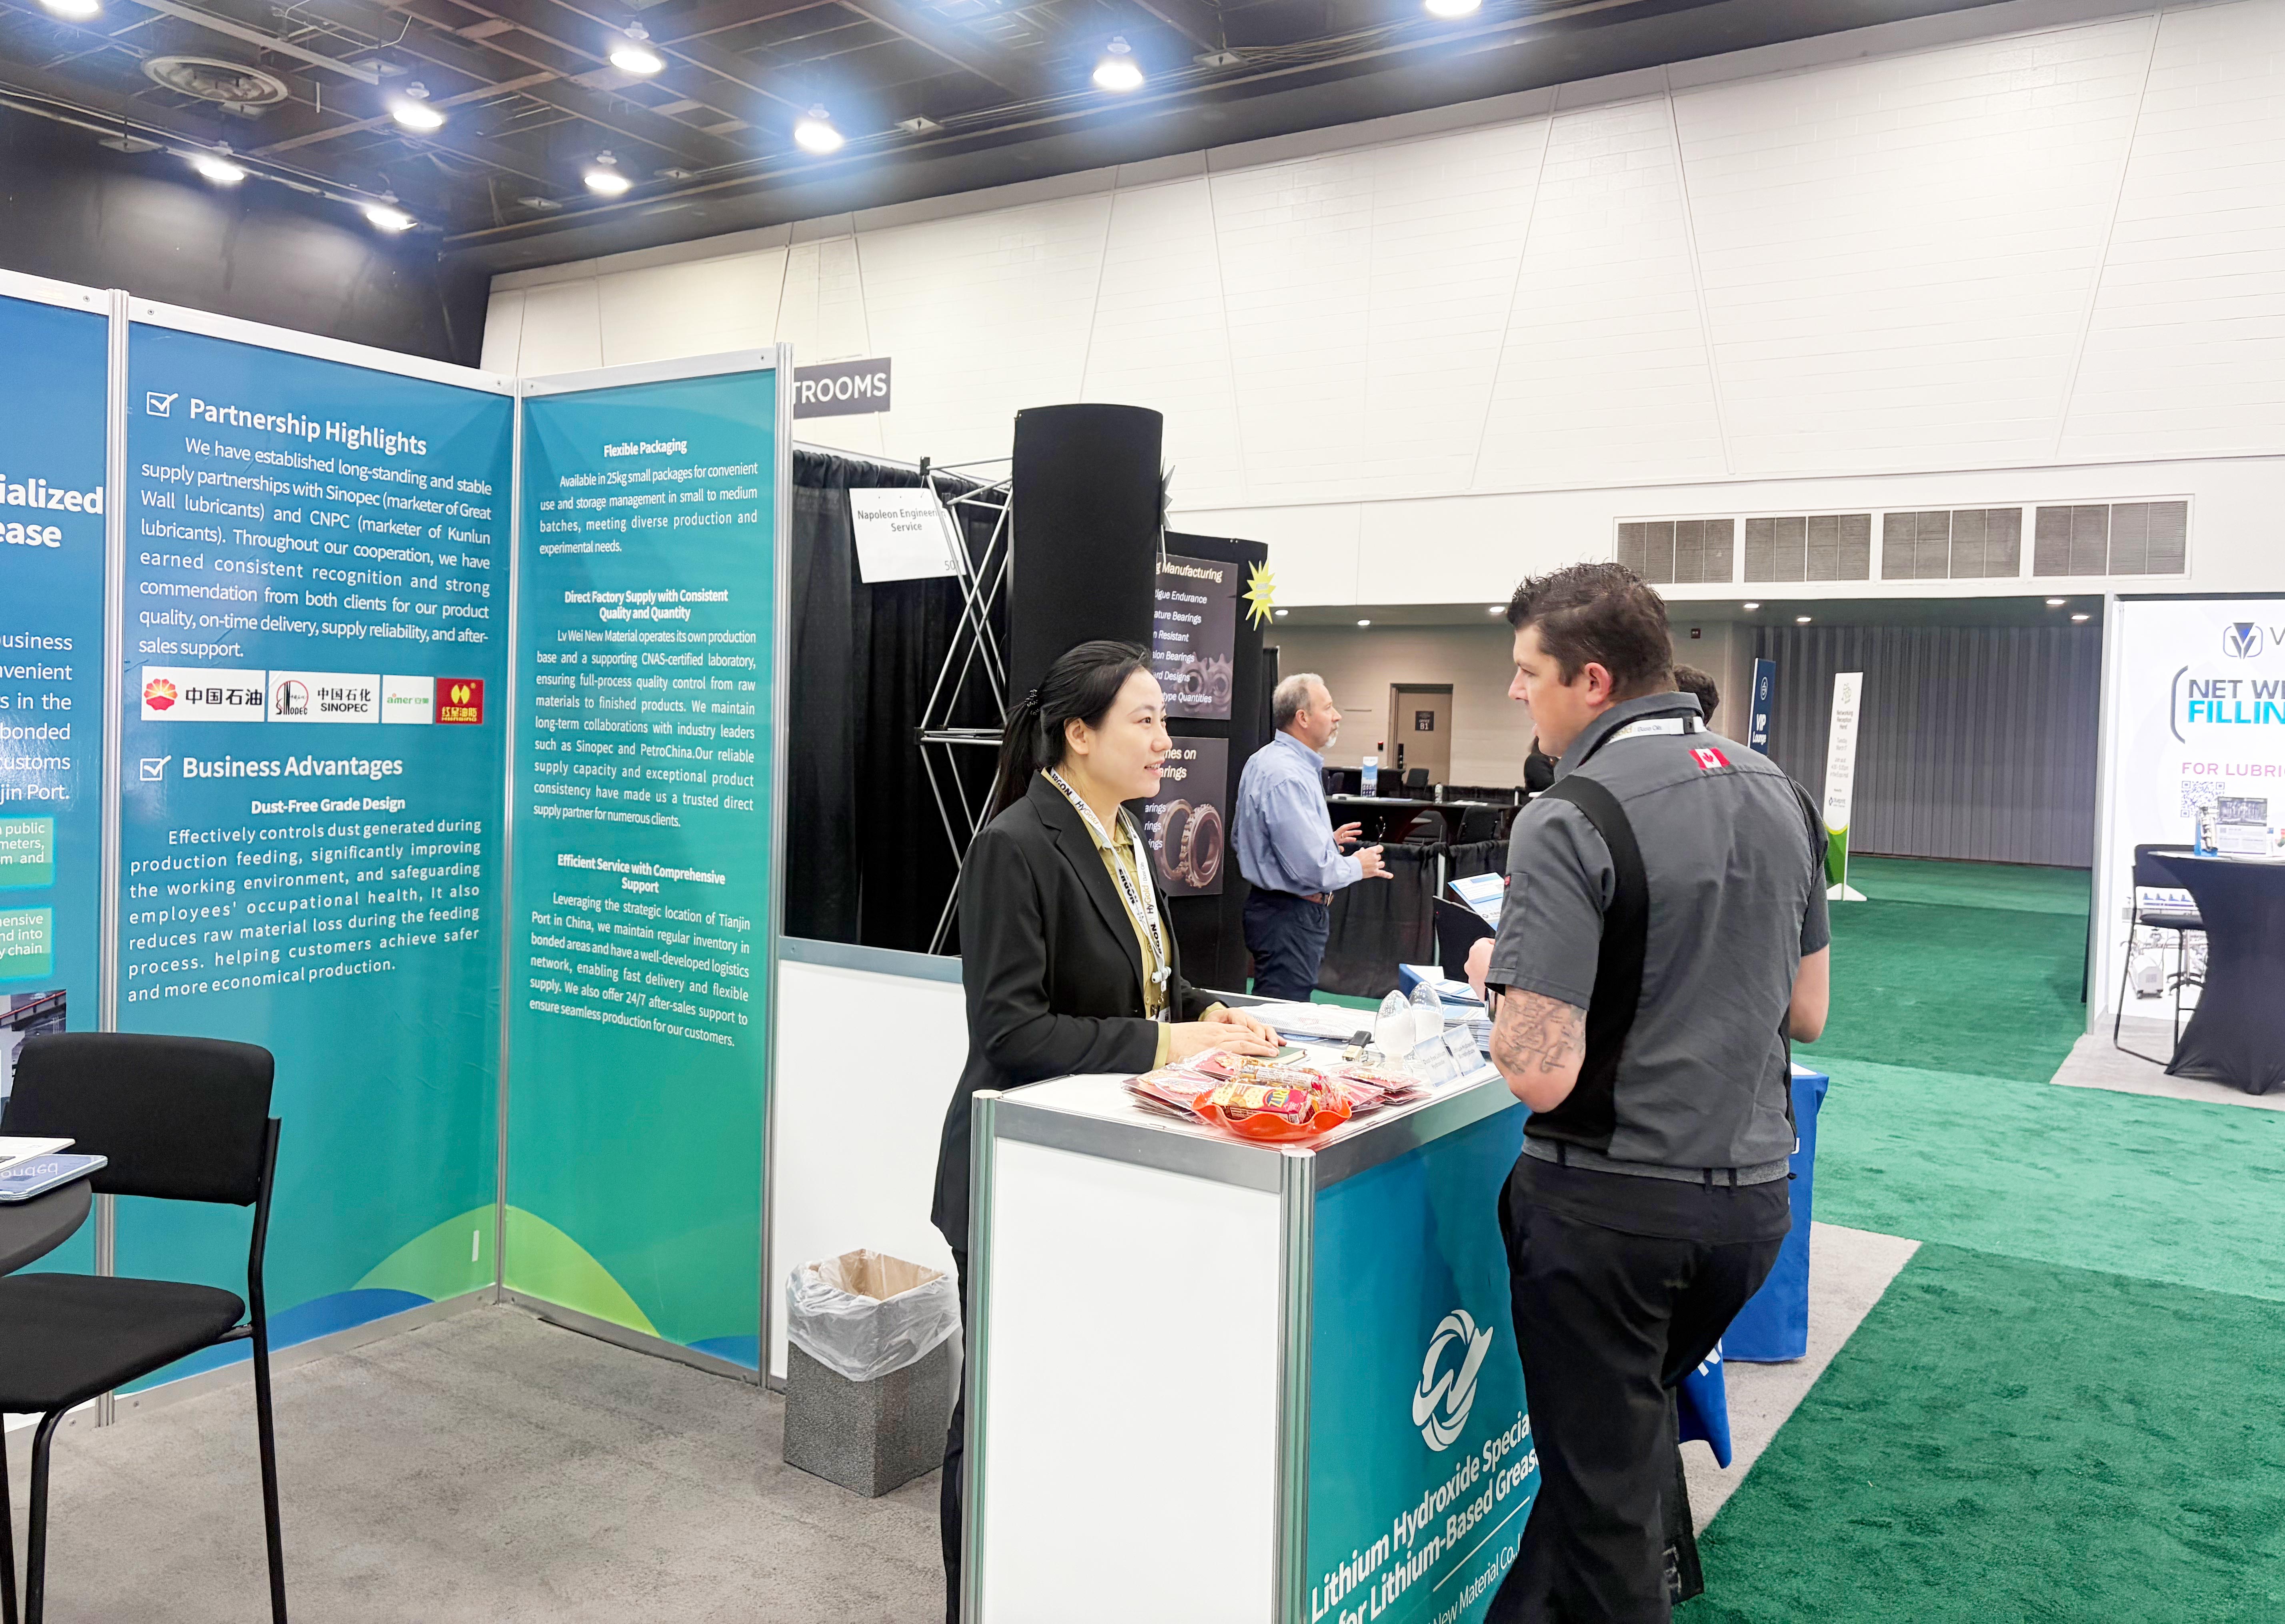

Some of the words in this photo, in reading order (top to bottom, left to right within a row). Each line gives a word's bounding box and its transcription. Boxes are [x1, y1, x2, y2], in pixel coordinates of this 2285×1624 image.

[190, 398, 320, 442] Partnership
[326, 421, 426, 455] Highlights
[604, 442, 638, 457] Flexible
[640, 438, 687, 455] Packaging
[186, 437, 210, 455] We
[215, 440, 250, 460] have
[255, 451, 334, 473] established
[339, 459, 427, 489] long-standing
[430, 476, 453, 490] and
[457, 479, 492, 495] stable
[560, 473, 596, 487] Available
[598, 473, 605, 484] in
[607, 471, 627, 486] 25kg
[628, 468, 650, 483] small
[652, 467, 692, 484] packages
[694, 465, 706, 478] for
[708, 462, 758, 477] convenient
[142, 464, 194, 485] supply
[198, 472, 290, 496] partnerships
[293, 482, 323, 498] with
[326, 485, 380, 507] Sinopec
[383, 492, 444, 513] (marketer
[446, 504, 458, 516] of
[459, 504, 492, 521] Great
[141, 490, 175, 509] Wall
[186, 494, 264, 522] lubricants)
[274, 508, 301, 523] and
[310, 510, 349, 528] CNPC
[358, 515, 422, 536] (marketer
[428, 525, 442, 538] of
[448, 527, 490, 544] Kunlun
[857, 509, 898, 521] Napoleon
[0, 522, 62, 548] ase
[891, 522, 922, 532] Service
[140, 553, 203, 569] earned
[215, 559, 303, 578] consistent
[313, 568, 401, 586] recognition
[410, 575, 437, 589] and
[446, 579, 490, 598] strong
[1162, 562, 1223, 583] Manufacturing
[565, 590, 591, 603] Direct
[592, 591, 624, 605] Factory
[626, 590, 656, 605] Supply
[658, 589, 678, 602] with
[680, 588, 728, 602] Consistent
[1171, 590, 1207, 604] Endurance
[600, 606, 631, 622] Quality
[633, 606, 649, 618] and
[651, 606, 690, 622] Quantity
[1173, 611, 1202, 625] Bearings
[0, 632, 72, 650] usiness
[1159, 630, 1189, 642] Resistant
[1166, 651, 1195, 664] Bearings
[0, 662, 72, 680] venient
[1164, 671, 1191, 683] Designs
[185, 686, 263, 706] 中国石油
[318, 687, 371, 702] 中国石化
[1178, 692, 1212, 703] Quantities
[2188, 680, 2243, 699] NET
[18, 692, 33, 710] in
[41, 692, 72, 710] the
[320, 702, 368, 712] SINOPEC
[0, 722, 70, 740] bonded
[1756, 714, 1767, 731] VIP
[1752, 731, 1767, 746] Lounge
[1184, 749, 1197, 760] on
[183, 756, 280, 778] Business
[284, 755, 403, 780] Advantages
[2182, 762, 2218, 775] FOR
[2226, 764, 2285, 777] LUBRI
[27, 784, 70, 800] Port.
[252, 800, 318, 814] Dust-Free
[320, 797, 360, 812] Grade
[363, 796, 405, 812] Design
[1075, 801, 1099, 825] HyGold
[5, 822, 45, 837] public
[169, 827, 255, 844] Effectively
[260, 824, 324, 840] controls
[328, 823, 360, 836] dust
[363, 819, 434, 838] generated
[438, 819, 481, 834] during
[20, 851, 44, 864] and
[131, 854, 226, 876] production
[237, 850, 302, 866] feeding,
[312, 844, 403, 864] significantly
[411, 841, 480, 858] improving
[558, 854, 595, 870] Efficient
[597, 859, 630, 873] Service
[631, 862, 652, 876] with
[653, 864, 725, 884] Comprehensive
[622, 877, 659, 894] Support
[1142, 885, 1154, 914] HyGold
[0, 914, 44, 927] ensive
[553, 892, 602, 912] Leveraging
[604, 898, 620, 911] the
[623, 902, 661, 919] strategic
[665, 906, 701, 923] location
[706, 912, 716, 925] of
[719, 914, 750, 932] Tianjin
[18, 928, 43, 940] into
[8, 942, 42, 956] chain
[1267, 1089, 1291, 1108] RITZ
[1311, 1533, 1389, 1623] Lithium
[1393, 1454, 1479, 1552] Hydroxide
[1482, 1411, 1531, 1472] Specia
[1371, 1485, 1493, 1620] Lithium-Based
[1459, 1553, 1499, 1614] Material
